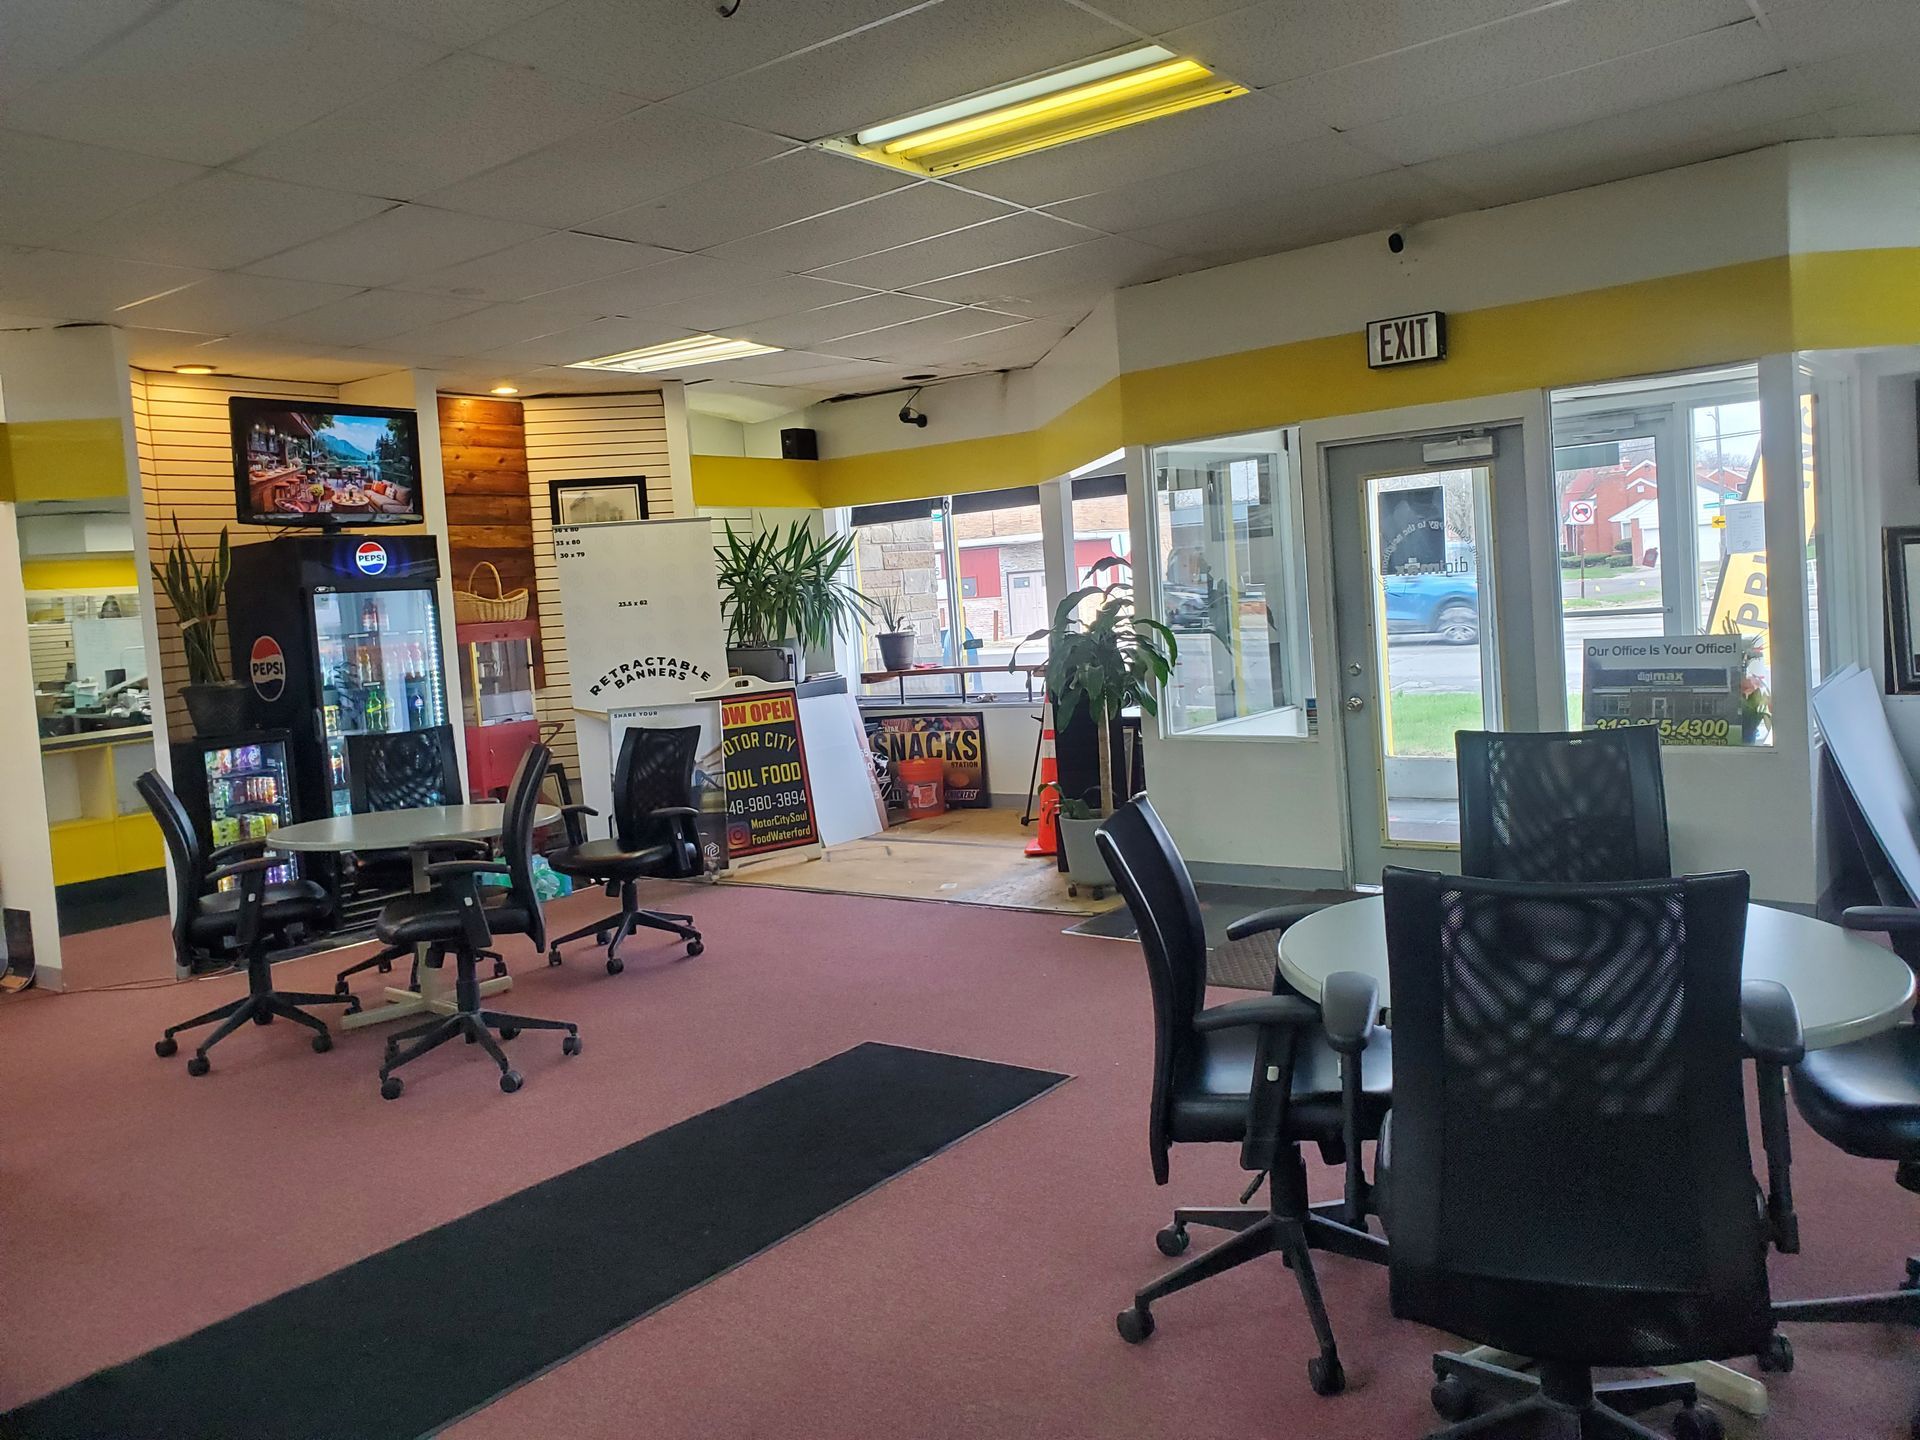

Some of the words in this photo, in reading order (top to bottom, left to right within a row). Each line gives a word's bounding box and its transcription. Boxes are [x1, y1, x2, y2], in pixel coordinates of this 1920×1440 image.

[1380, 317, 1429, 362] EXIT
[358, 554, 385, 562] PEPSI
[1587, 646, 1608, 657] Our
[1612, 645, 1646, 656] Office
[1650, 644, 1660, 655] Is
[1663, 643, 1692, 655] Your
[1695, 642, 1737, 655] Office!
[252, 661, 284, 676] PEPSI
[589, 656, 711, 696] RETRACTABLE
[614, 668, 687, 689] BANNERS
[1637, 671, 1684, 683] digimax
[722, 703, 747, 726] OW
[750, 699, 792, 723] OPEN
[723, 731, 760, 758] OTOR
[765, 731, 796, 752] CITY
[873, 730, 978, 761] SNACKS
[726, 768, 758, 791] OUL
[761, 761, 802, 786] FOOD
[727, 789, 807, 816] 48-980-3894
[751, 810, 808, 829] MotorCitySoul
[752, 825, 811, 845] FoodWaterford
